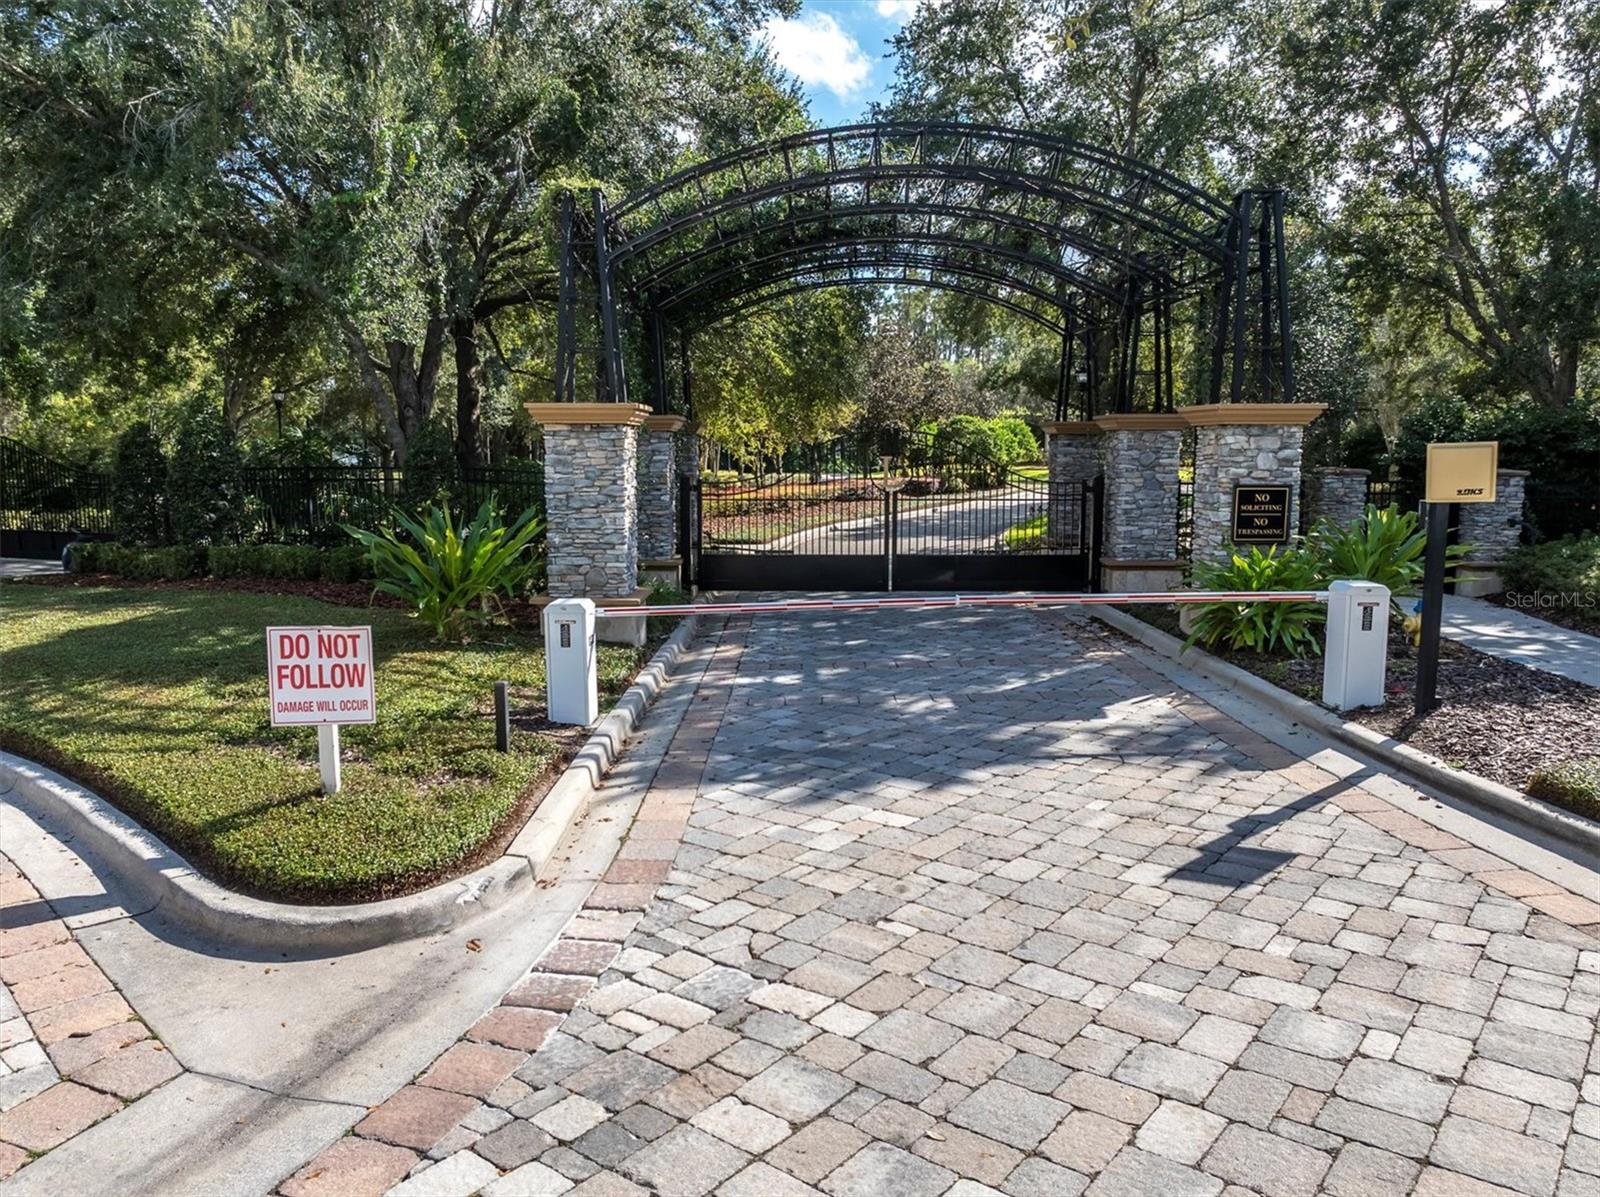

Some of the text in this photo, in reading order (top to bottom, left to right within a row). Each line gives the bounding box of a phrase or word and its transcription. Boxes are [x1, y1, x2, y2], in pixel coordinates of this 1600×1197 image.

[1254, 493, 1270, 502] NO
[1253, 517, 1269, 527] NO
[279, 634, 361, 660] DO NOT
[276, 663, 366, 690] FOLLOW
[277, 699, 369, 713] DAMAGE WILL OCCUR
